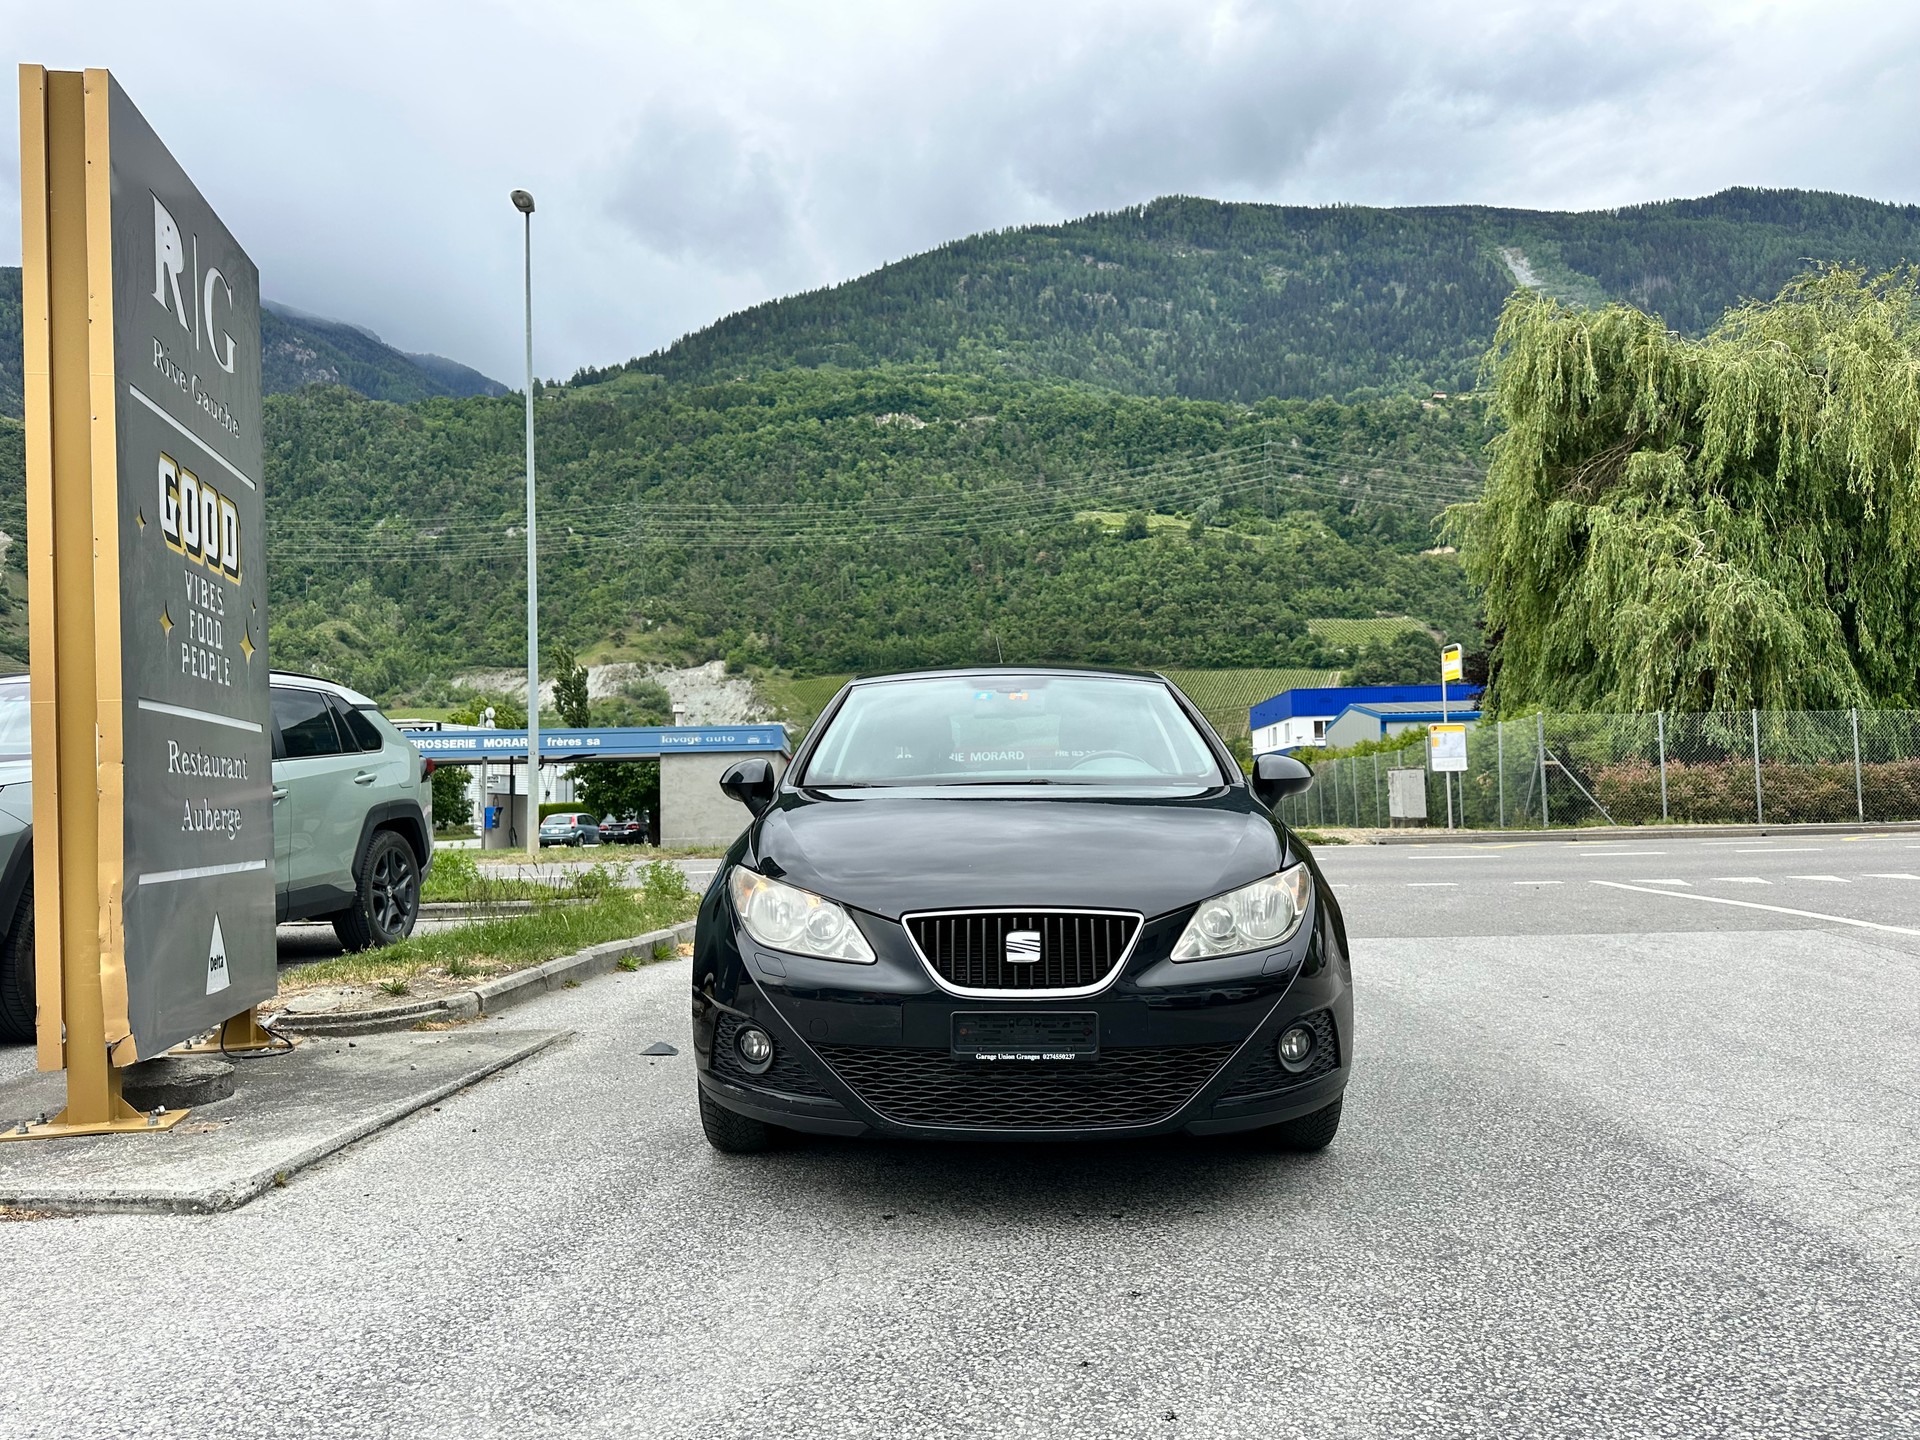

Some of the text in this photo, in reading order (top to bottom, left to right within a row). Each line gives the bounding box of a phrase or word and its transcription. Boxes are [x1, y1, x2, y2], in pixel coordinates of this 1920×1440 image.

[152, 335, 240, 438] Rive Gauche
[158, 452, 242, 585] GOOD
[184, 569, 225, 616] VIBES
[189, 609, 223, 650] FOOD
[181, 642, 232, 686] PEOPLE
[483, 738, 529, 748] MORAR
[546, 736, 582, 747] frères
[586, 737, 601, 746] sa
[661, 734, 735, 745] lavage auto
[970, 751, 1025, 762] MORARD
[167, 740, 248, 781] Restaurant
[181, 798, 242, 841] Auberge
[975, 1053, 997, 1061] Garage
[1016, 1053, 1040, 1061] Granges
